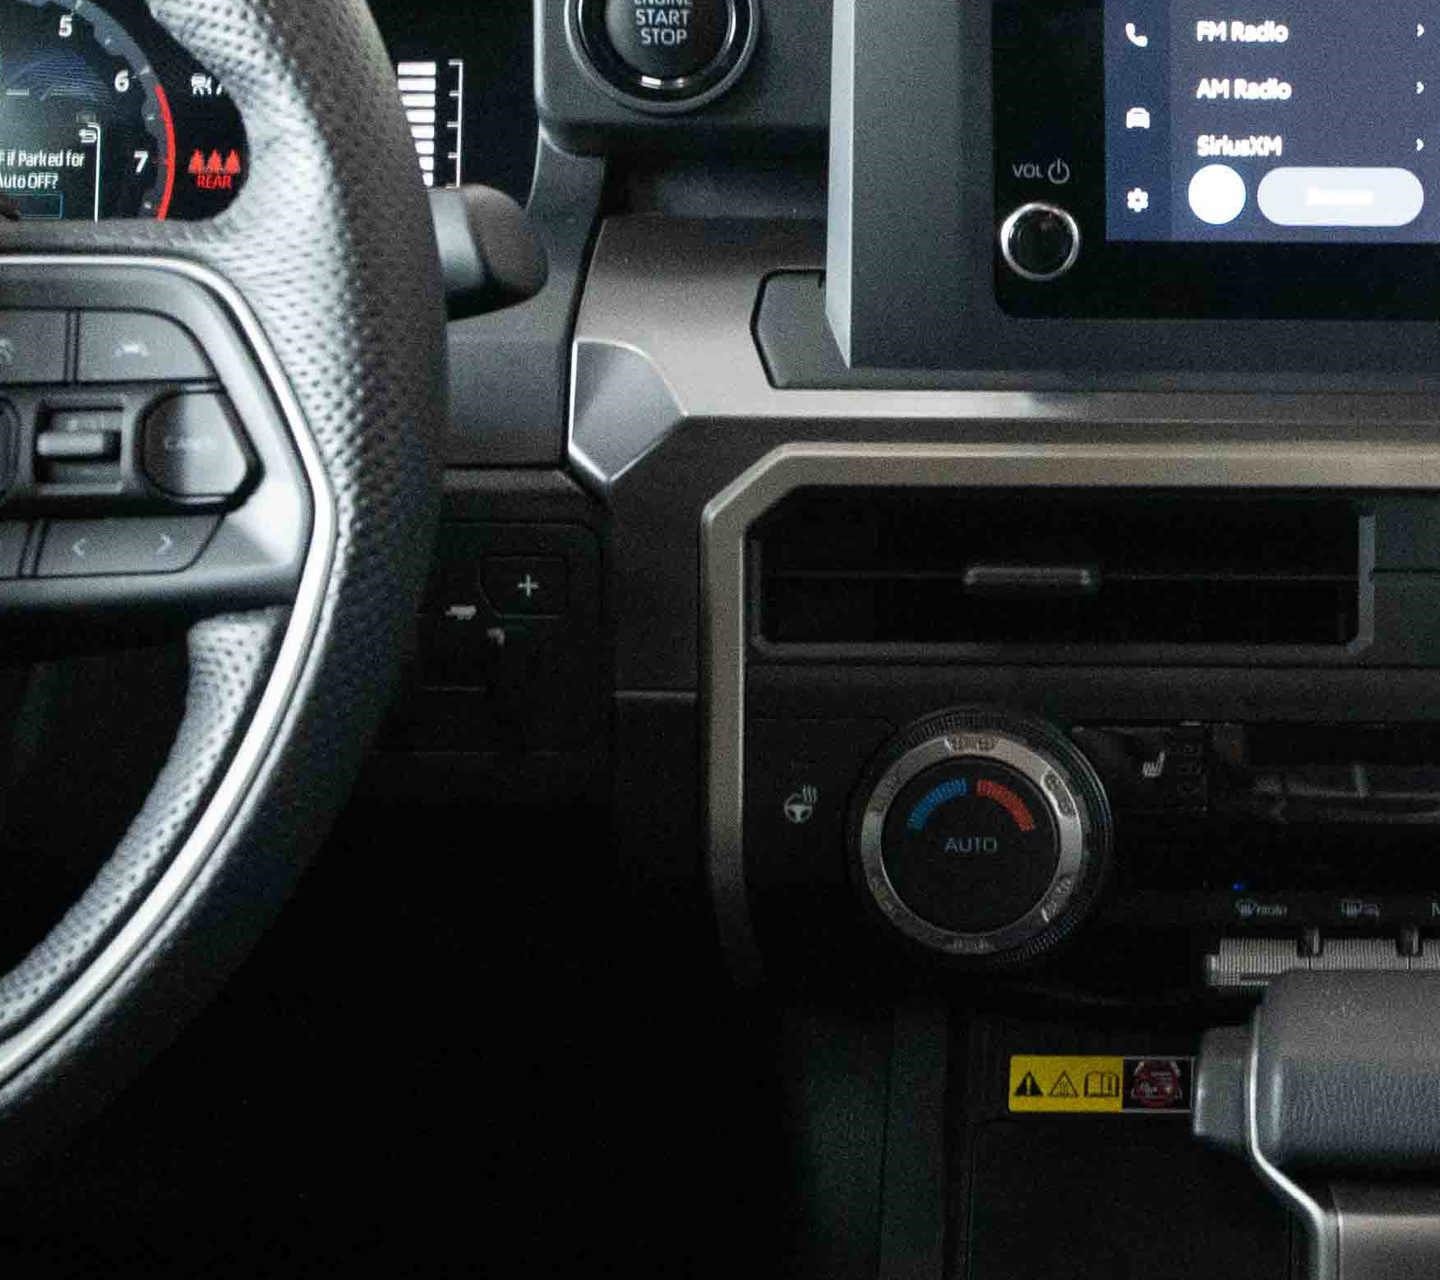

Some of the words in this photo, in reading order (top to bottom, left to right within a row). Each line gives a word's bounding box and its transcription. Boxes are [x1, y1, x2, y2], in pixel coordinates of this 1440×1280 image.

[58, 12, 74, 38] 5
[635, 8, 690, 25] START
[641, 28, 688, 45] STOP
[1196, 20, 1227, 43] FM
[1230, 19, 1290, 44] Radio
[114, 70, 130, 93] 6
[1195, 77, 1230, 100] AM
[1233, 77, 1293, 101] Radio
[1196, 133, 1283, 158] SiriusXM
[7, 149, 16, 167] if
[17, 149, 63, 168] Parked
[65, 149, 86, 168] for
[133, 150, 149, 173] 7
[1011, 162, 1044, 179] VOL
[27, 172, 59, 190] OFF?
[196, 174, 232, 189] REAR
[943, 836, 998, 854] AUTO
